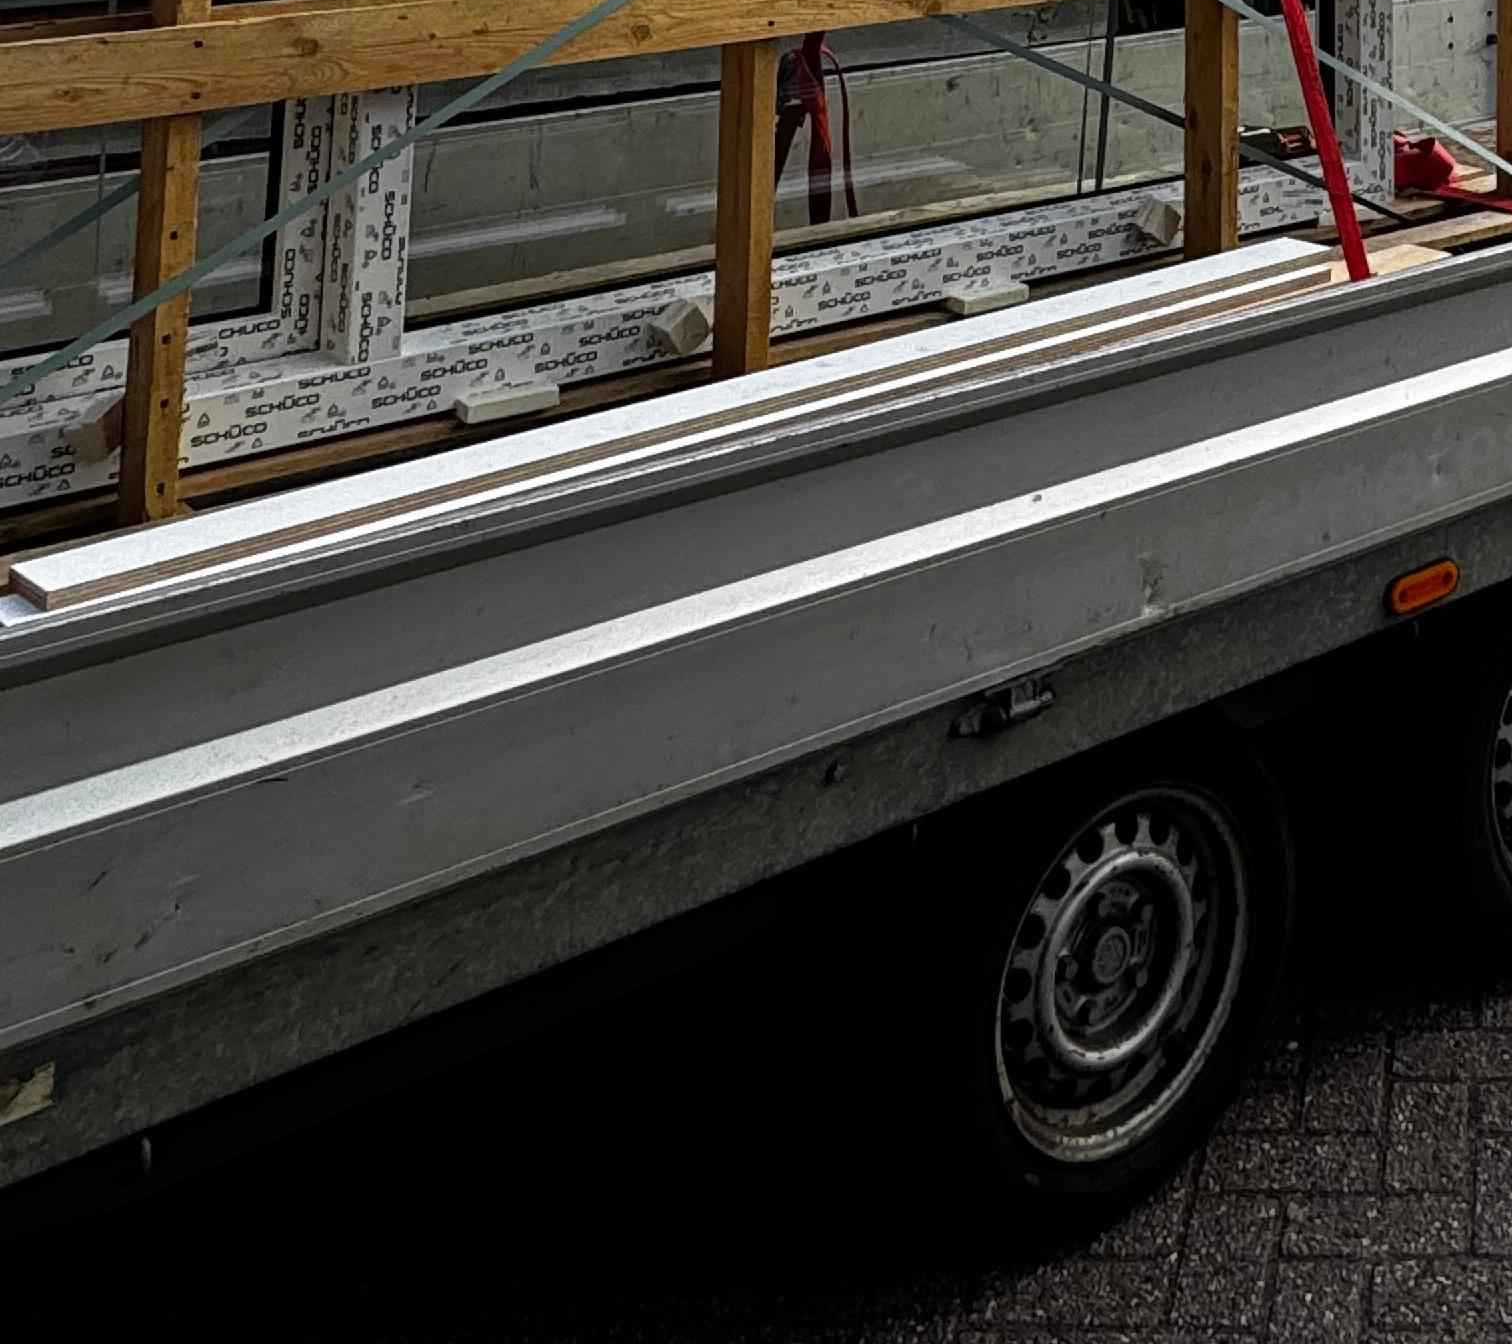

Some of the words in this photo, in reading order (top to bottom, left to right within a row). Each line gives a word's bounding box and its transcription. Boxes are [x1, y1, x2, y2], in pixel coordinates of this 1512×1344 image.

[244, 393, 320, 419] SCHÜCO
[371, 384, 441, 410] SCHÜCO
[190, 421, 267, 448] SCHÜCO
